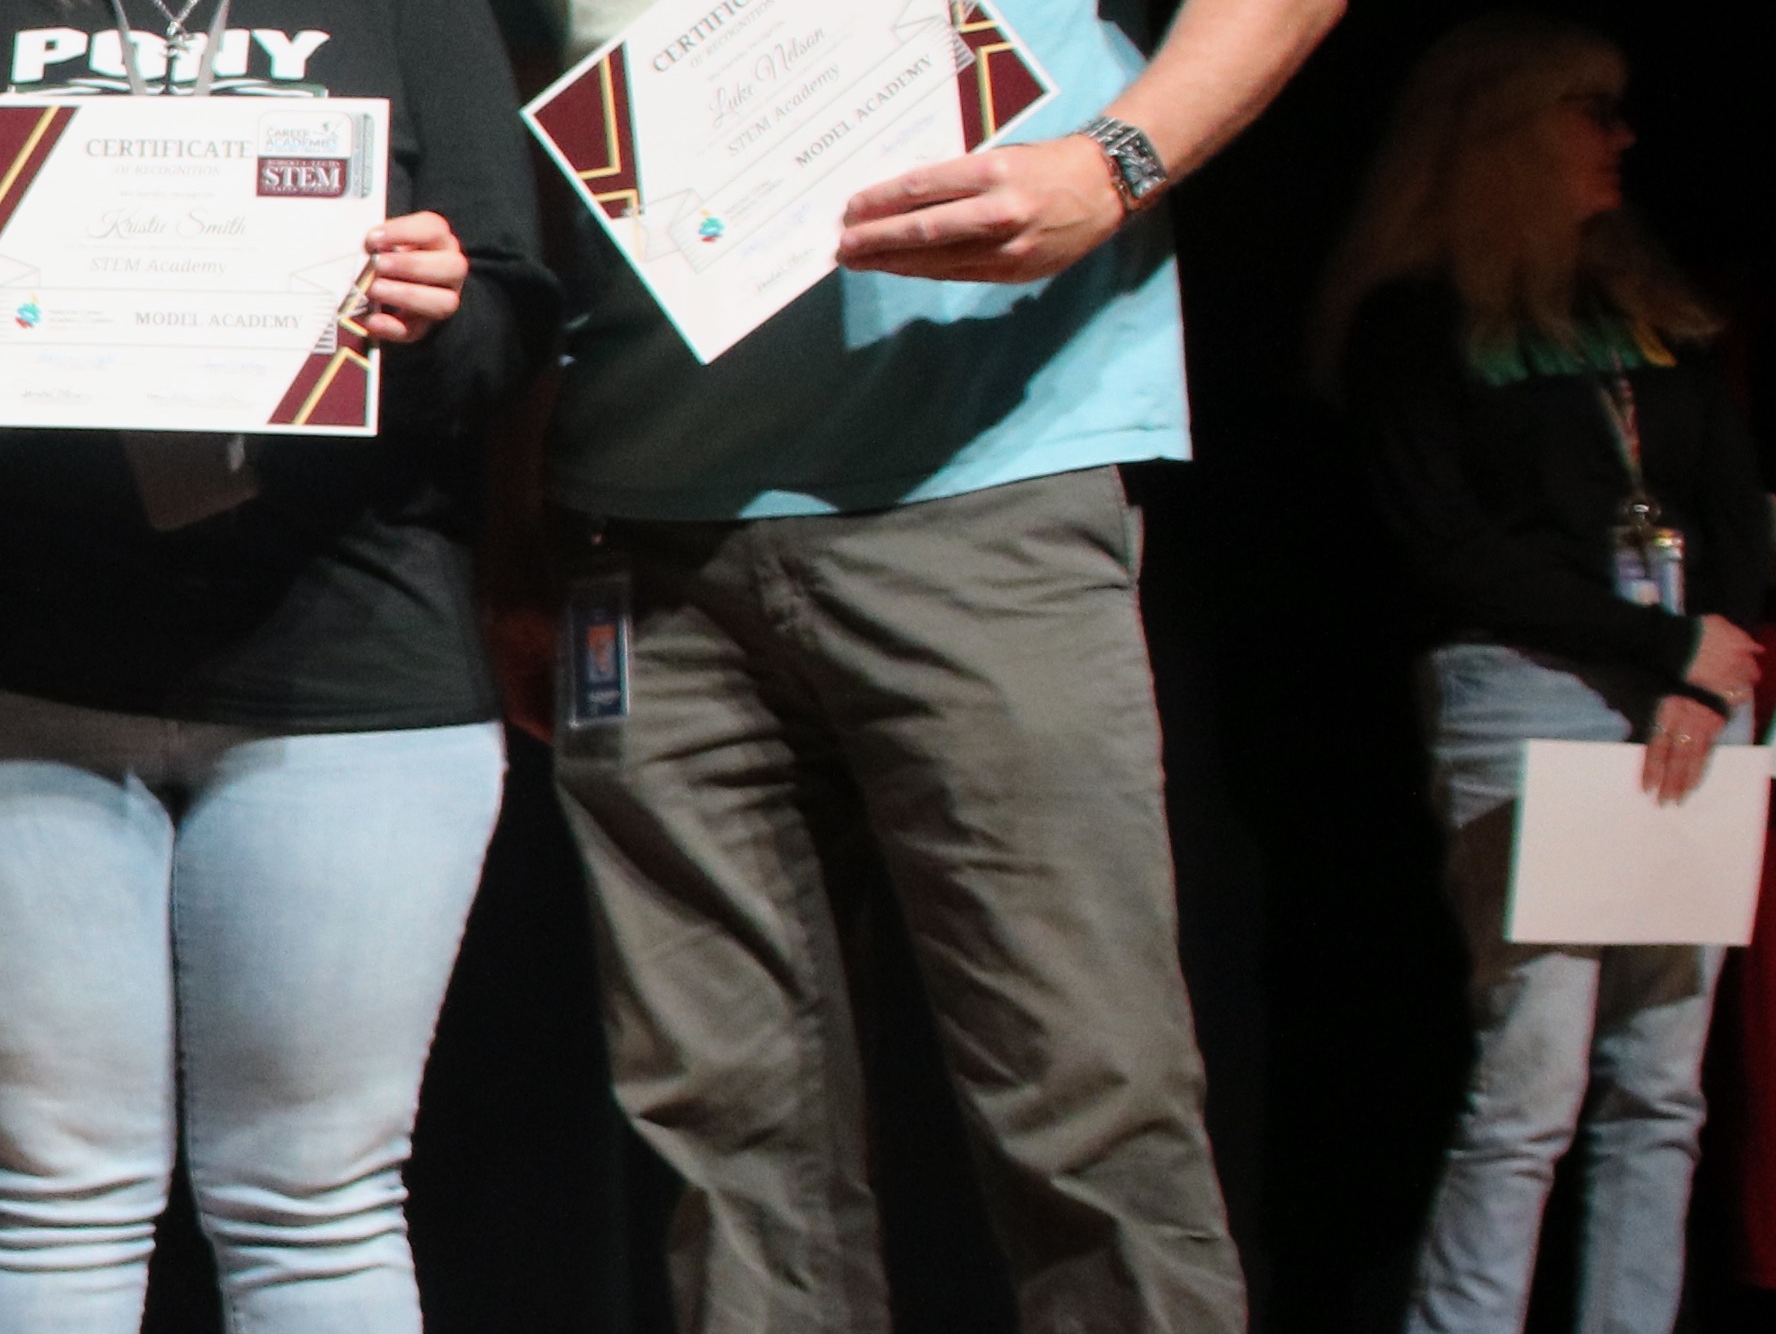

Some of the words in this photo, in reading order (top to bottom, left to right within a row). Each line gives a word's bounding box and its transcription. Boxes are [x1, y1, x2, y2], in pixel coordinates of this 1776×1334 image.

[12, 28, 330, 82] PONY
[708, 82, 754, 130] Luke
[752, 27, 825, 82] Nelson
[726, 115, 771, 157] STEM
[773, 64, 840, 123] Academy
[794, 120, 855, 167] MODEL
[855, 57, 932, 122] ACADEMY
[86, 137, 253, 159] CERTIFICATE
[134, 164, 220, 176] RECOGNITION
[263, 165, 340, 187] STEM
[175, 207, 245, 237] Smith
[90, 257, 140, 272] STEM
[145, 256, 227, 276] Academy
[135, 312, 199, 326] MODEL
[209, 313, 302, 328] ACADEMY
